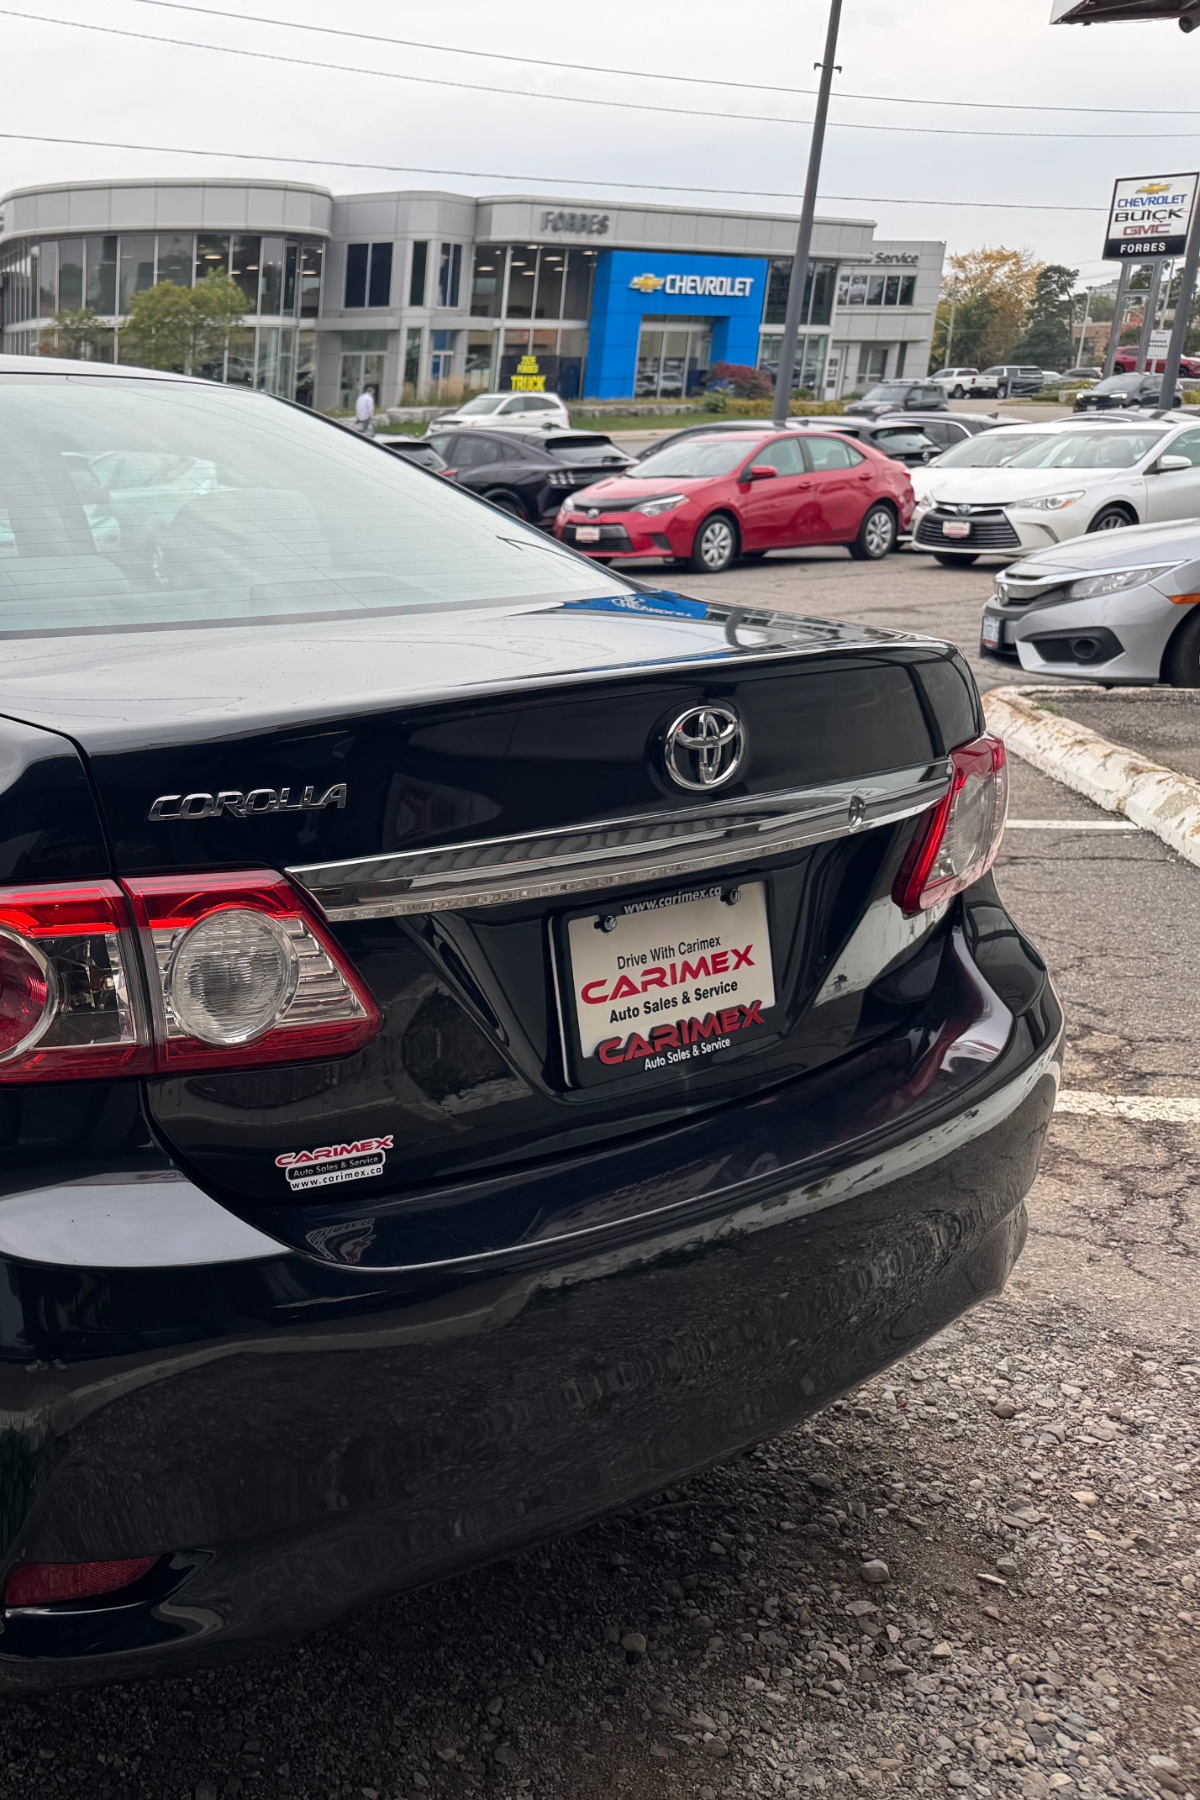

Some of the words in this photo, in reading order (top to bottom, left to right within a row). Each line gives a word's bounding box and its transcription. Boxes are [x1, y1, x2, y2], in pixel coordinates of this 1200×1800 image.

[1117, 194, 1188, 208] CHEVROLET
[1114, 208, 1184, 223] BUICK
[1123, 223, 1171, 236] GMC
[875, 252, 919, 264] Service
[1120, 242, 1166, 254] FORBES
[665, 274, 754, 297] CHEVROLET
[511, 375, 547, 392] TRUCK
[149, 783, 347, 821] COROLLA
[624, 886, 722, 914] www.carimex.ca
[617, 953, 647, 970] Drive
[650, 944, 675, 962] With
[678, 935, 721, 955] Carimex
[581, 944, 755, 1004] CARIMEX
[609, 1006, 640, 1023] Auto
[643, 995, 678, 1015] Sales
[682, 991, 691, 1005] &
[694, 980, 738, 1001] Service
[596, 999, 764, 1065] CARIMEX
[644, 1055, 665, 1071] Auto
[667, 1049, 691, 1063] Sales
[692, 1046, 699, 1056] &
[701, 1037, 731, 1053] Service
[276, 1136, 392, 1166] CARIMEX
[292, 1167, 382, 1189] www.carimex.ca
[293, 1168, 314, 1178] Auto
[316, 1163, 338, 1173] Sales
[340, 1161, 347, 1169] &
[349, 1156, 379, 1167] Service
